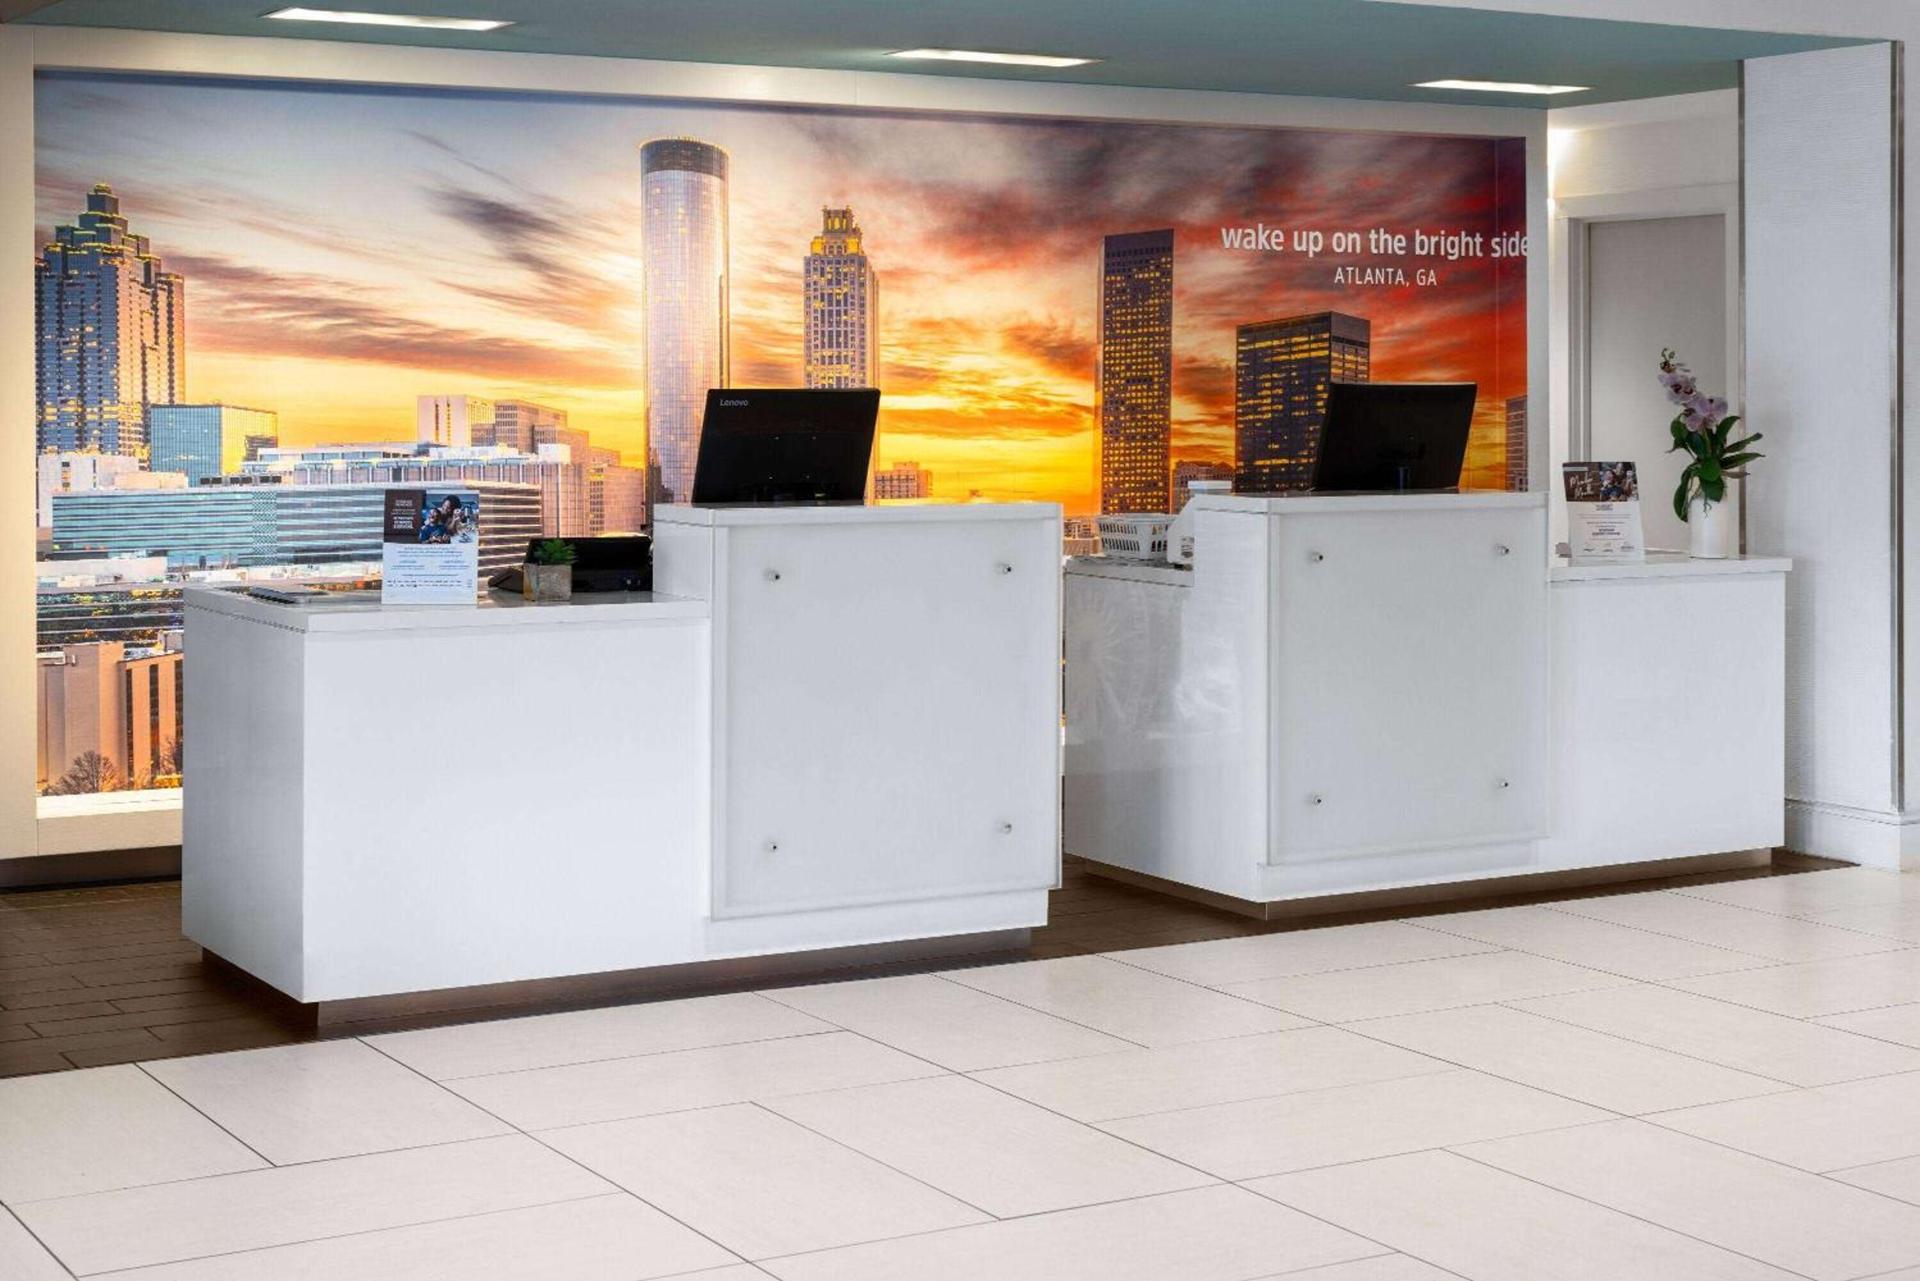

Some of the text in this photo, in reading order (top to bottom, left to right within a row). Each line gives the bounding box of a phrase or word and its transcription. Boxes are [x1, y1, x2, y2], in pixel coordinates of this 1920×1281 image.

[1221, 223, 1528, 260] wake up on the bright side
[1334, 267, 1437, 288] ATLANTA, GA
